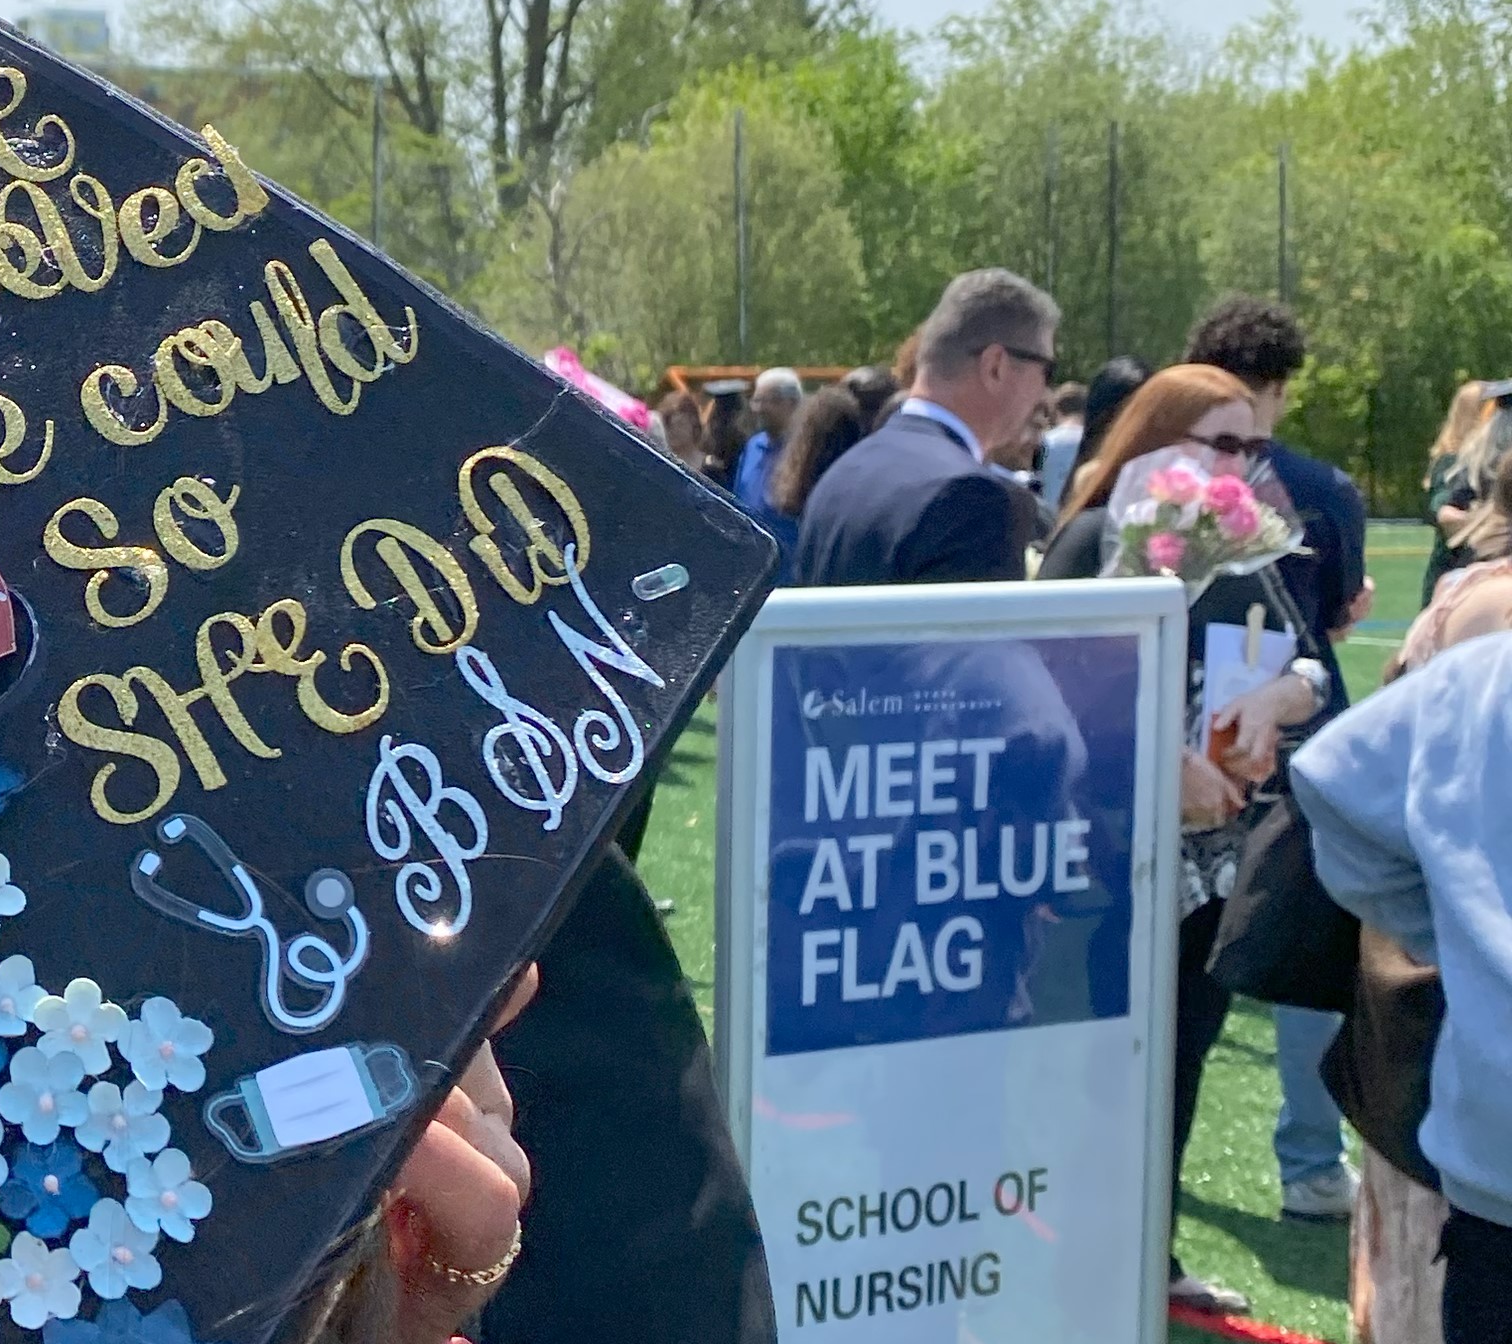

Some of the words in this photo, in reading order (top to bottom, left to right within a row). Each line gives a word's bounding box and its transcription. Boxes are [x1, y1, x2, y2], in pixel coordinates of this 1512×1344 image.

[81, 237, 419, 446] could
[366, 542, 666, 938] BSN
[831, 686, 903, 716] Salem
[804, 737, 1006, 823] MEET
[798, 834, 893, 915] AT
[916, 819, 1091, 905] BLUE
[801, 915, 985, 1007] FLAG
[796, 1180, 980, 1246] SCHOOL
[994, 1168, 1048, 1216] OF
[795, 1252, 1001, 1327] NURSING
